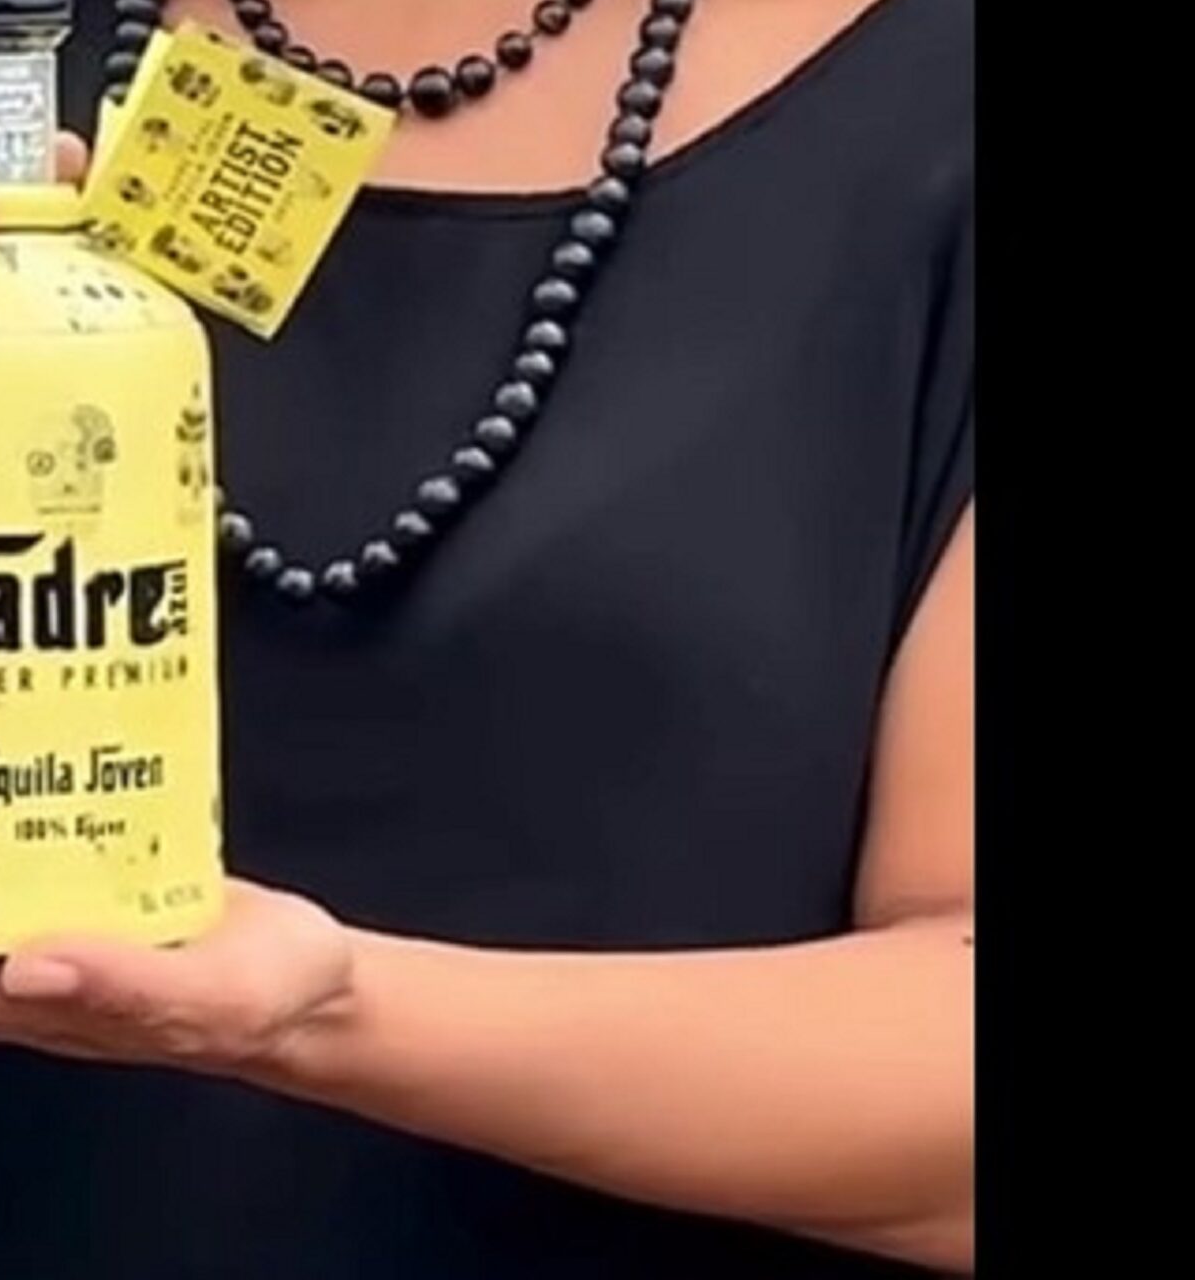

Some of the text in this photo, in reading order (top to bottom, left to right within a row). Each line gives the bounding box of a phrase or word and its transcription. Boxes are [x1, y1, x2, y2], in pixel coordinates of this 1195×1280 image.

[191, 121, 270, 236] ARTIST
[213, 129, 305, 255] EDITION
[84, 745, 164, 793] Joven
